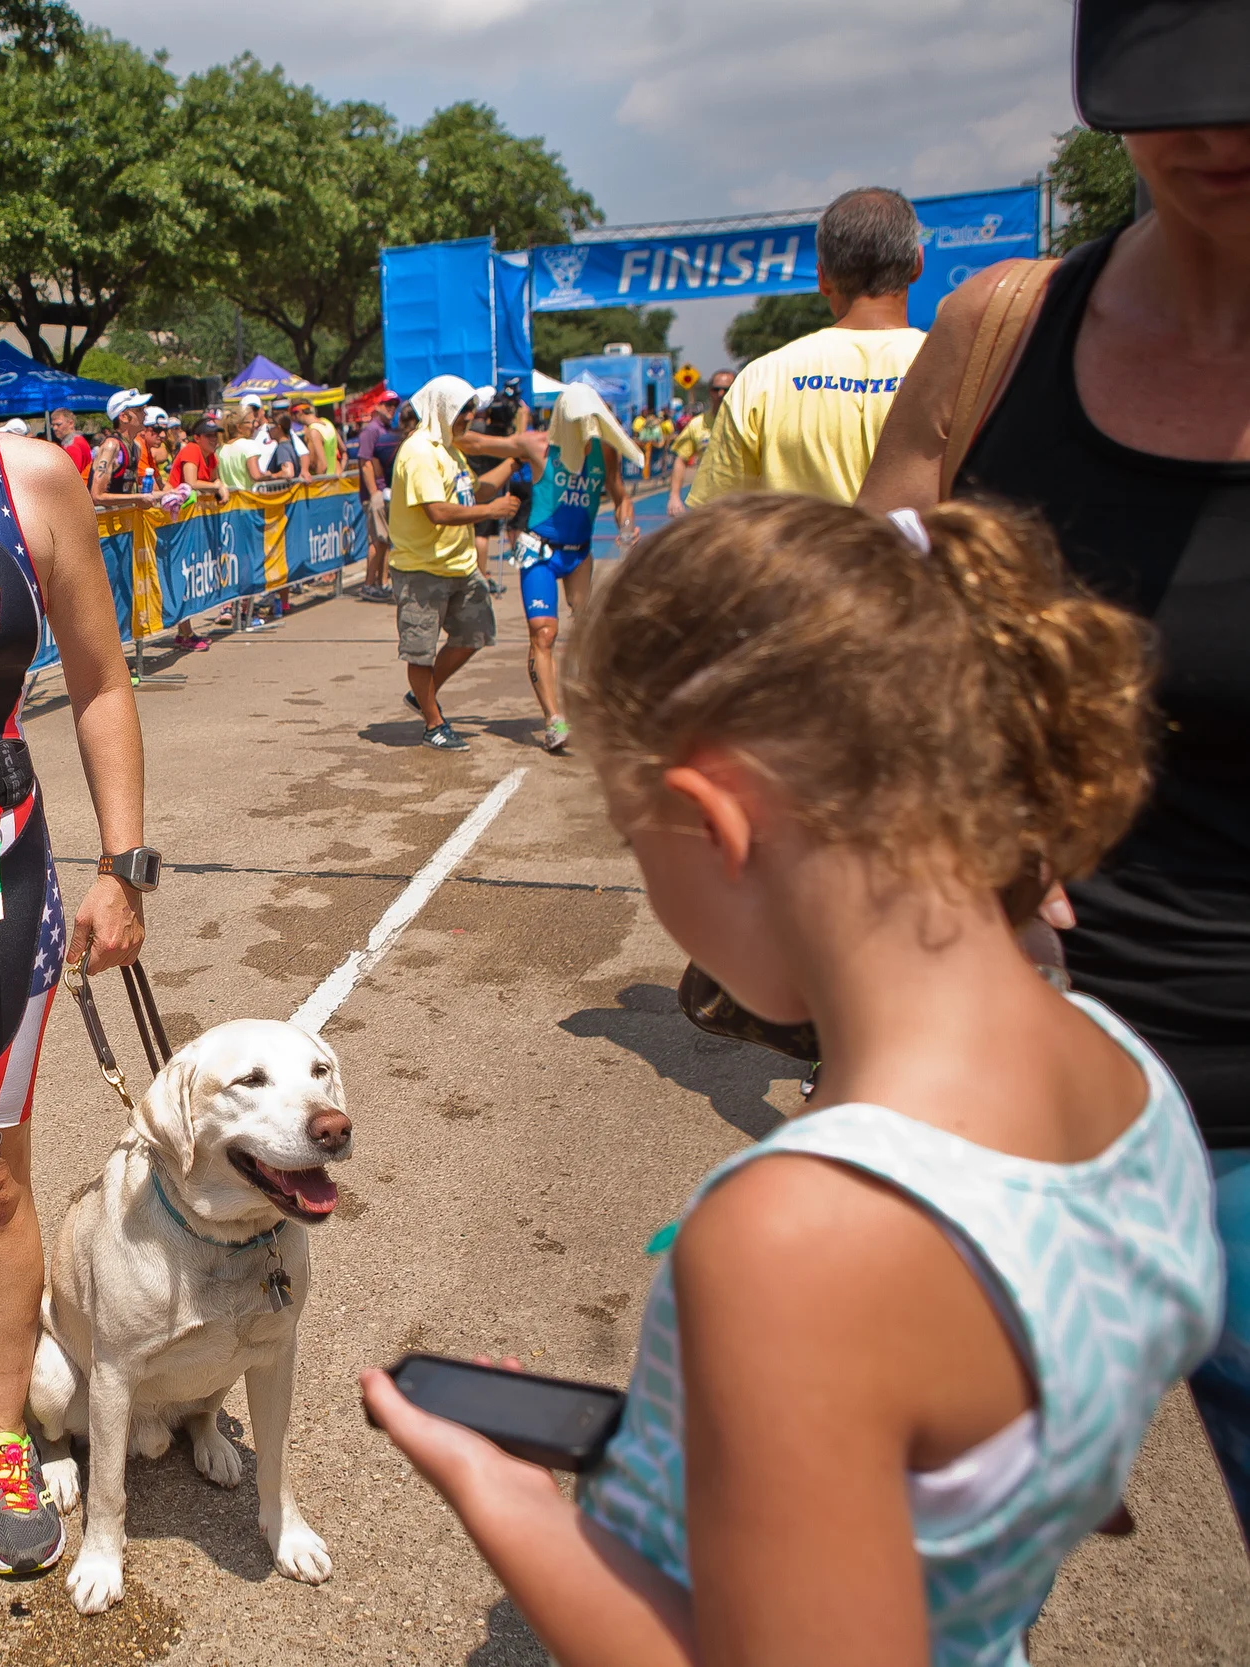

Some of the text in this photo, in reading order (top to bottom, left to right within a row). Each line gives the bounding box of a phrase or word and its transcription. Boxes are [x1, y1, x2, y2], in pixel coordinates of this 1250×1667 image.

[617, 235, 800, 295] FINISH
[793, 375, 904, 394] VOLUNTE
[558, 490, 591, 508] ARG
[528, 659, 539, 684] 78
